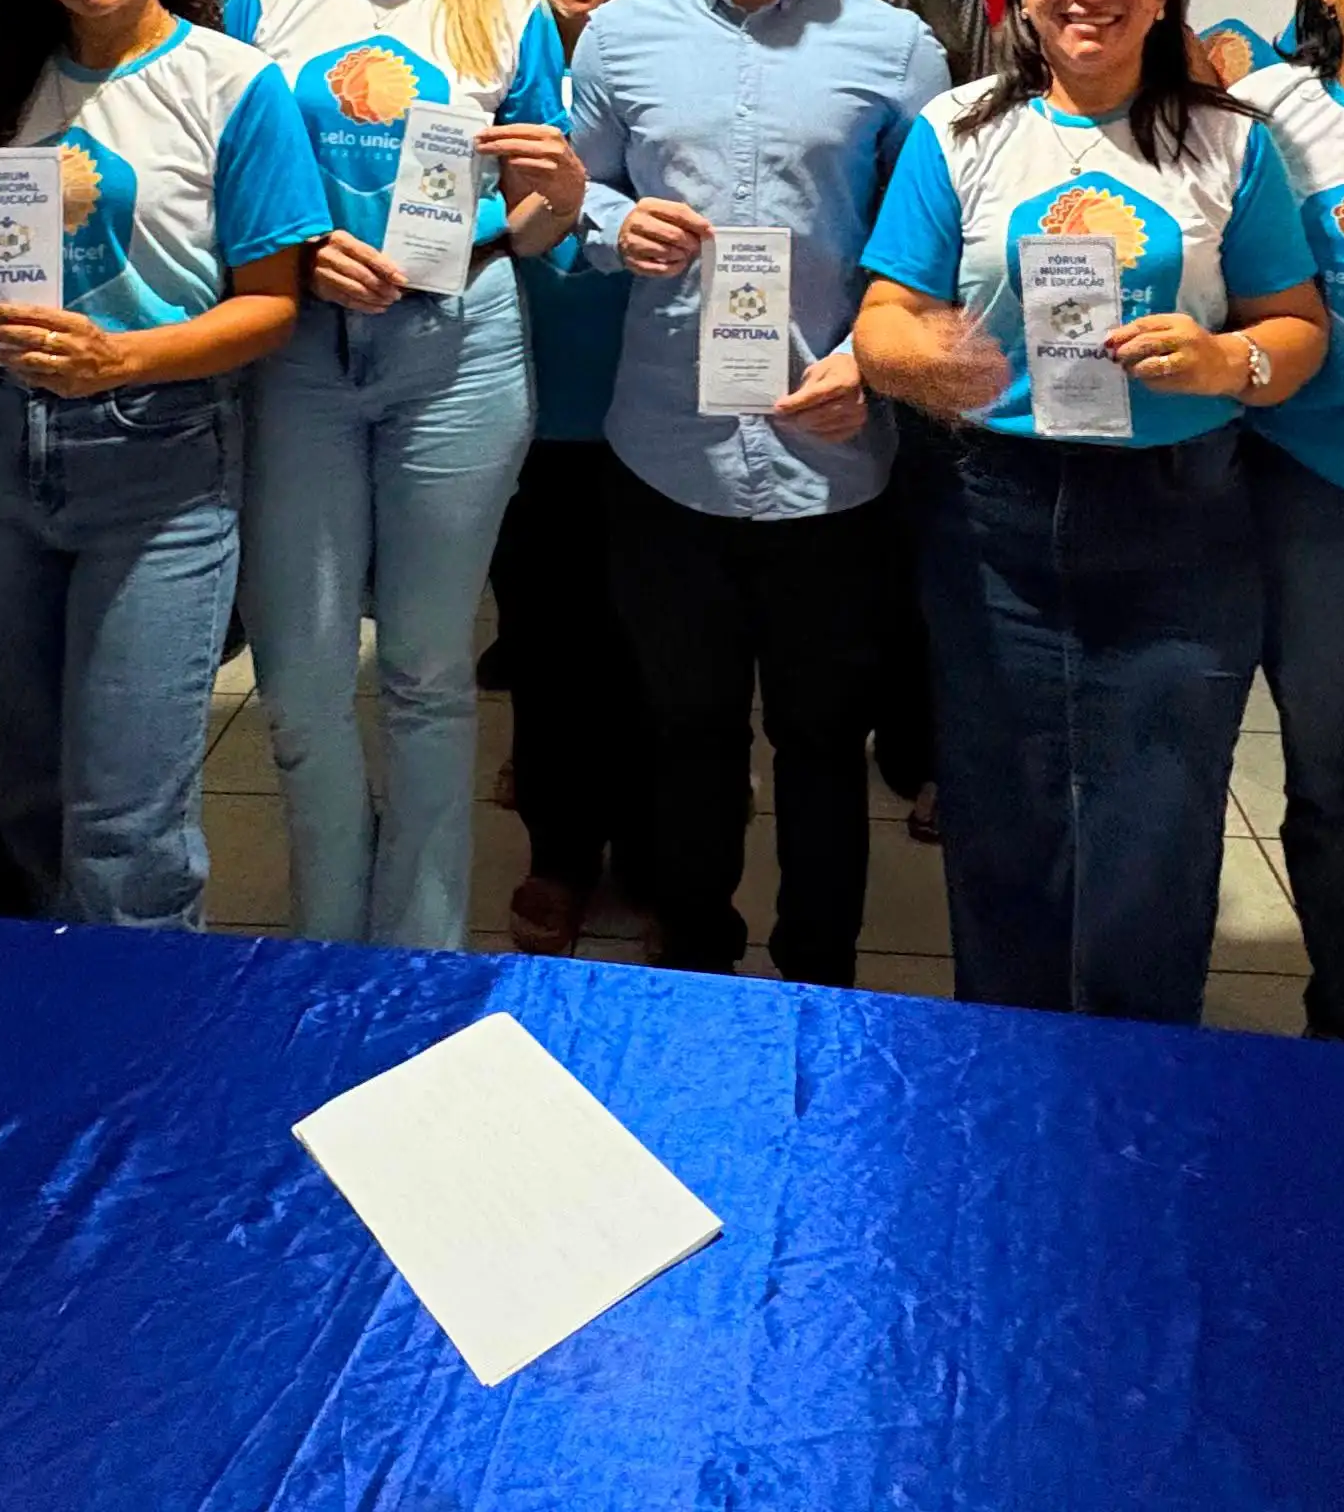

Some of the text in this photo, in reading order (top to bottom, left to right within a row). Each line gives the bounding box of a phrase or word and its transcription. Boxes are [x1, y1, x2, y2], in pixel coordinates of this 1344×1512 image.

[319, 129, 401, 150] selo unic
[399, 203, 464, 225] FORTUNA
[712, 327, 780, 340] FORTUNA
[1037, 345, 1108, 360] FORTUNA
